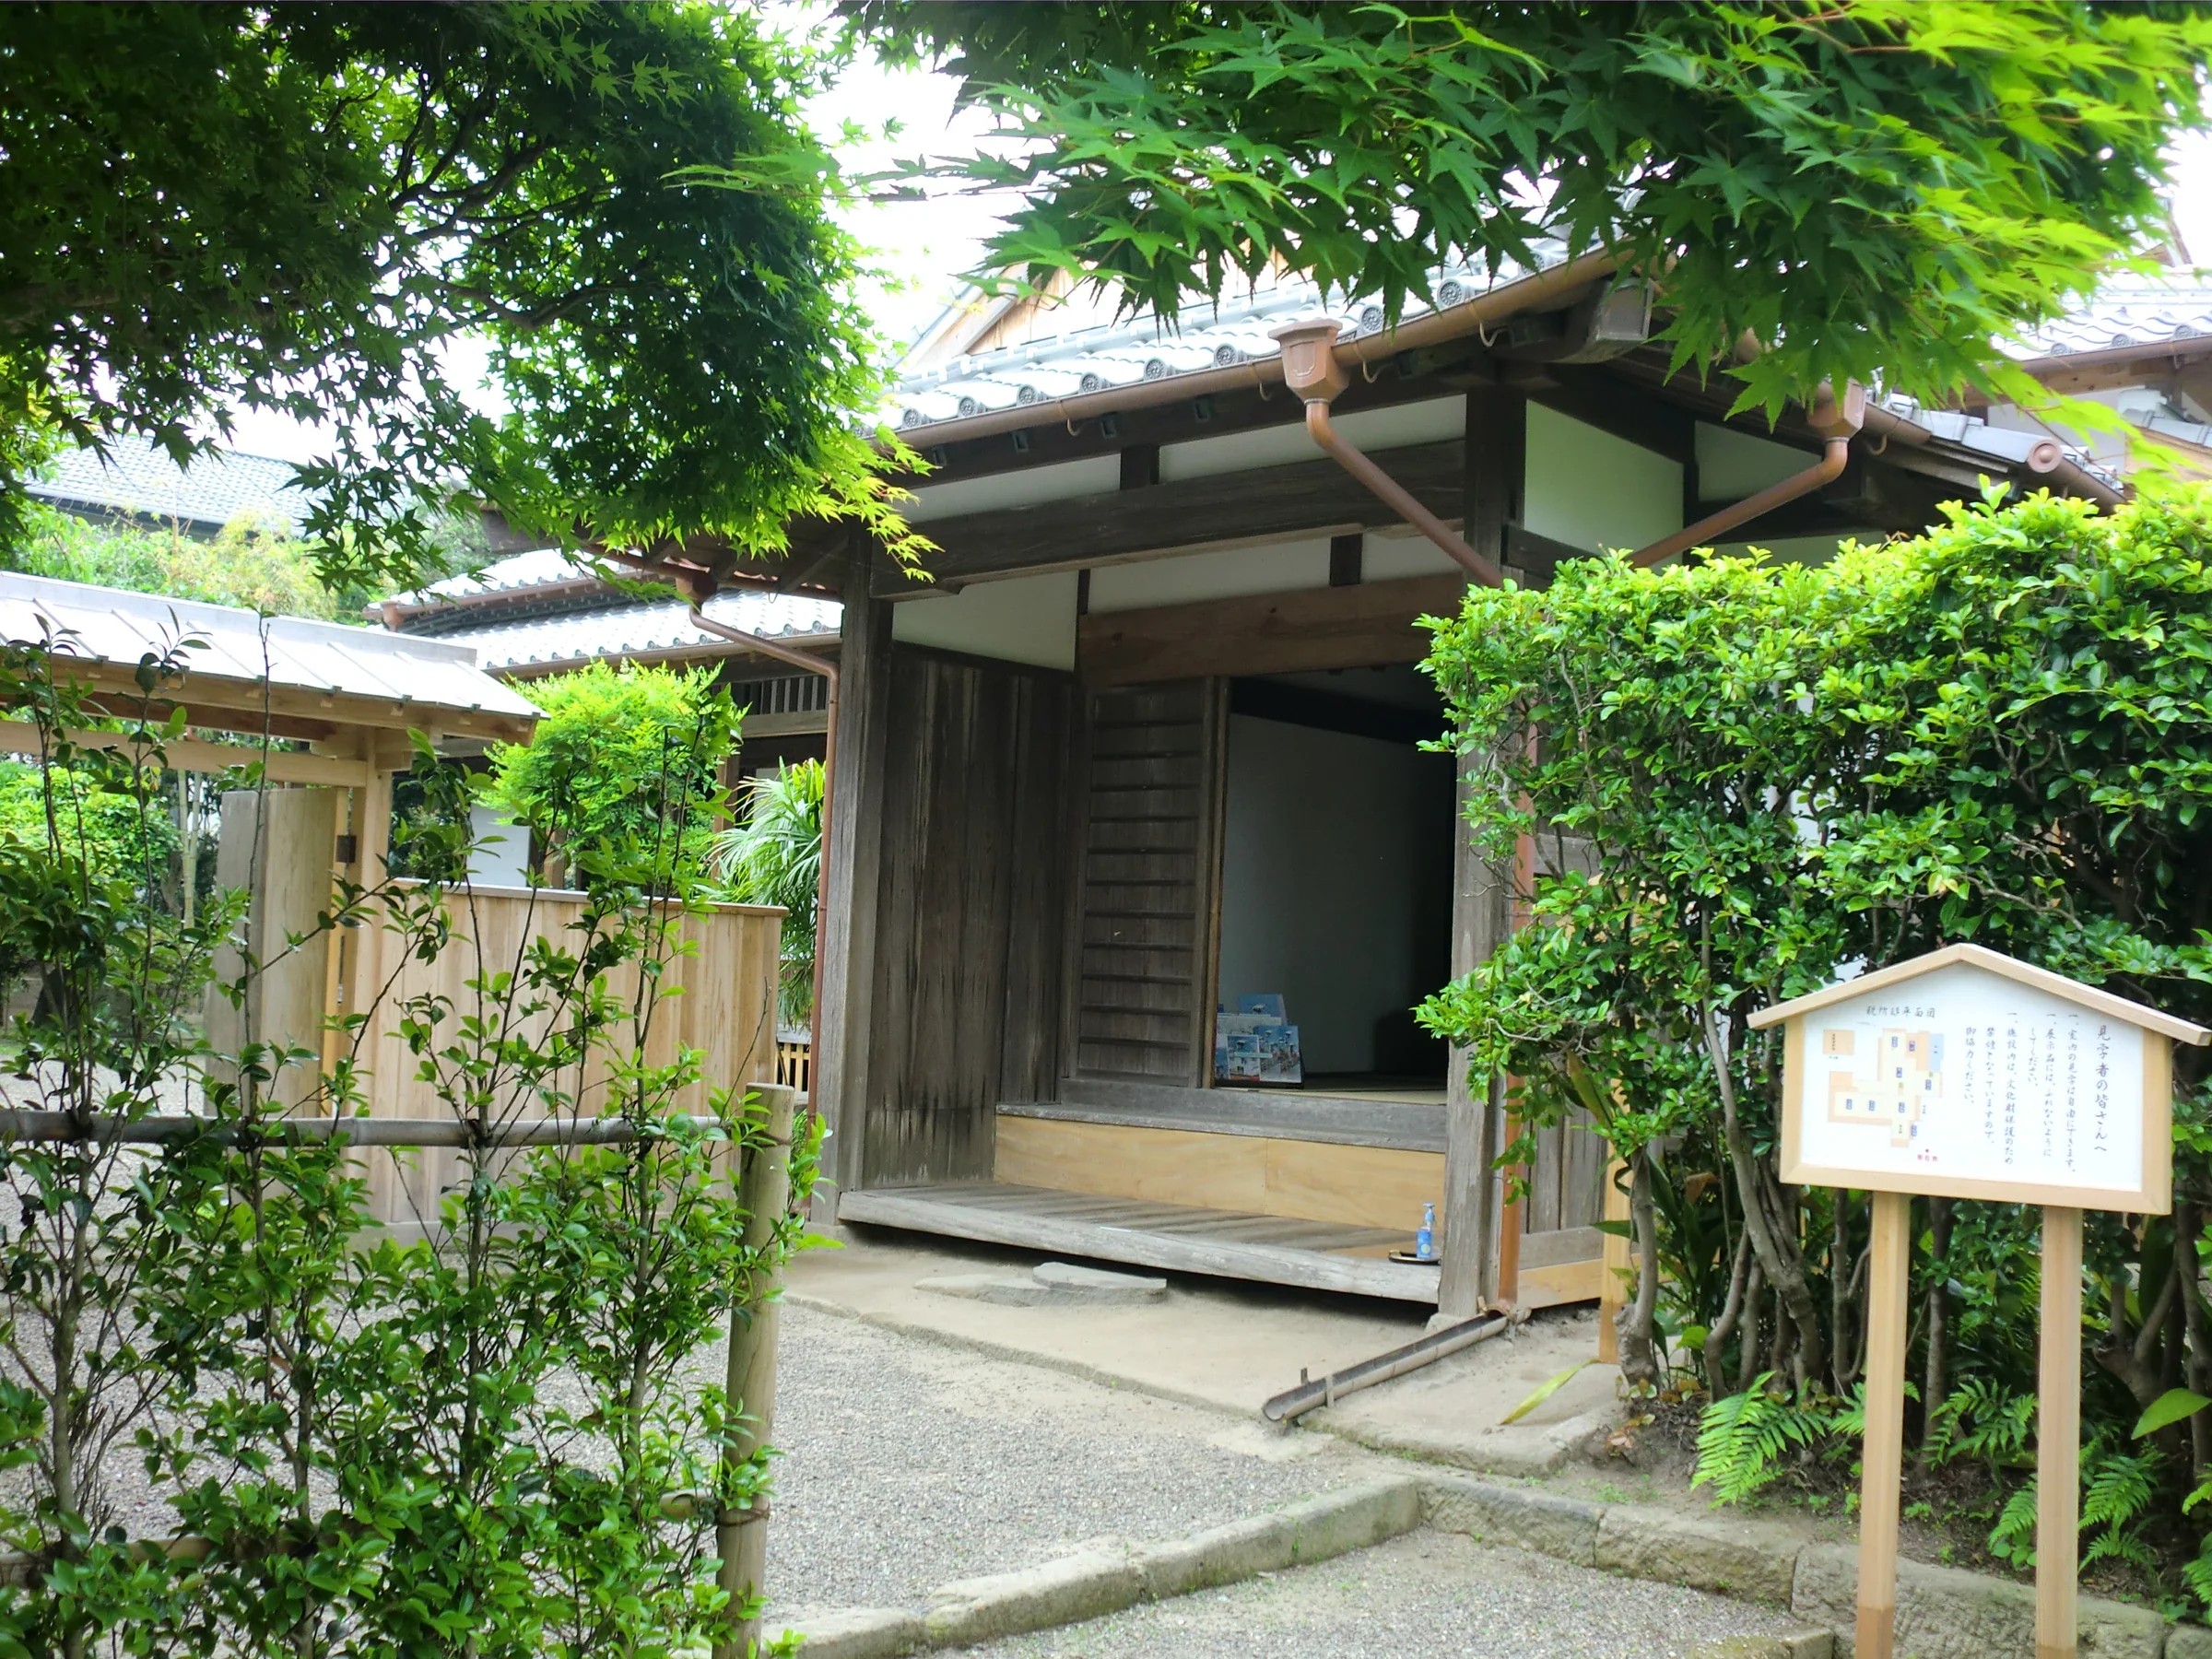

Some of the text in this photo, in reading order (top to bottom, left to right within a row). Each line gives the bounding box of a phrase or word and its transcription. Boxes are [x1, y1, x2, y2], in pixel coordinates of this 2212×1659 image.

[2094, 1024, 2111, 1152] 見学者の皆さんへ
